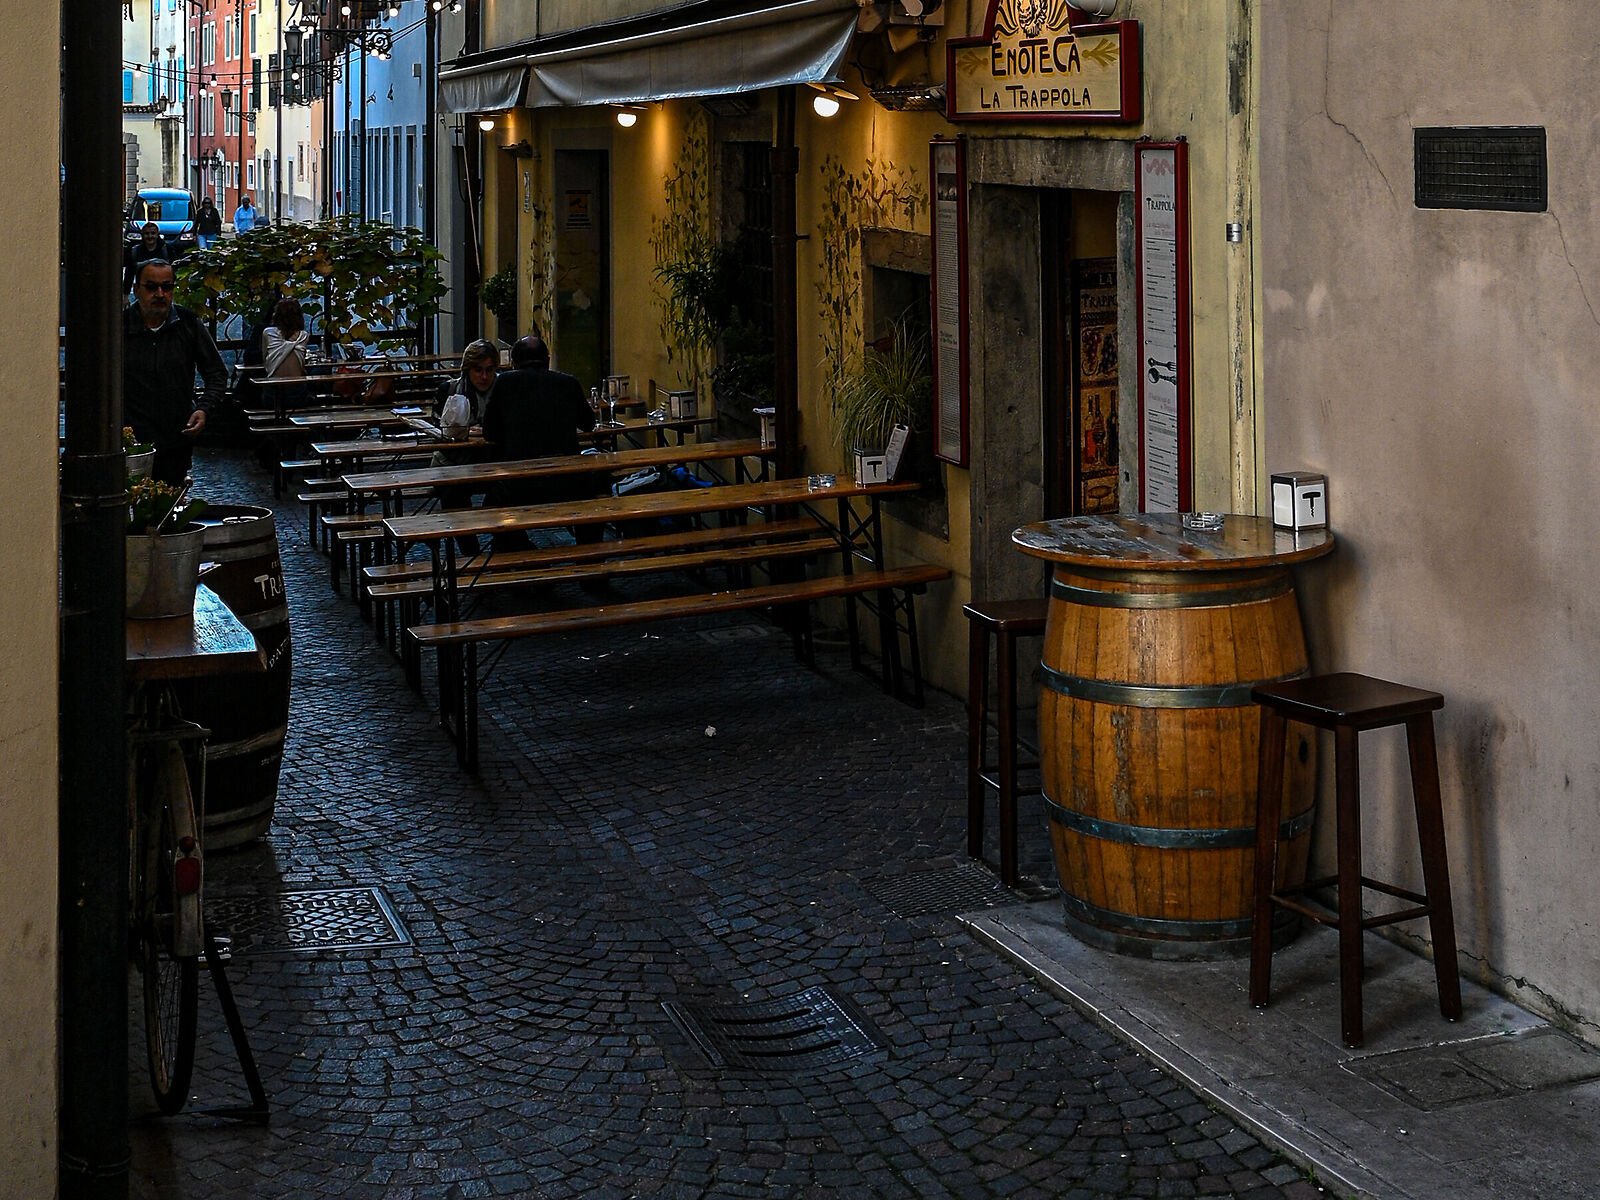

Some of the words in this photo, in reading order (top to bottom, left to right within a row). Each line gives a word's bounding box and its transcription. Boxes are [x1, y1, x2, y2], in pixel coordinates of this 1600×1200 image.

[991, 35, 1081, 77] ENOTECA
[980, 87, 1001, 109] LA
[1005, 84, 1091, 108] TRAPPOLA
